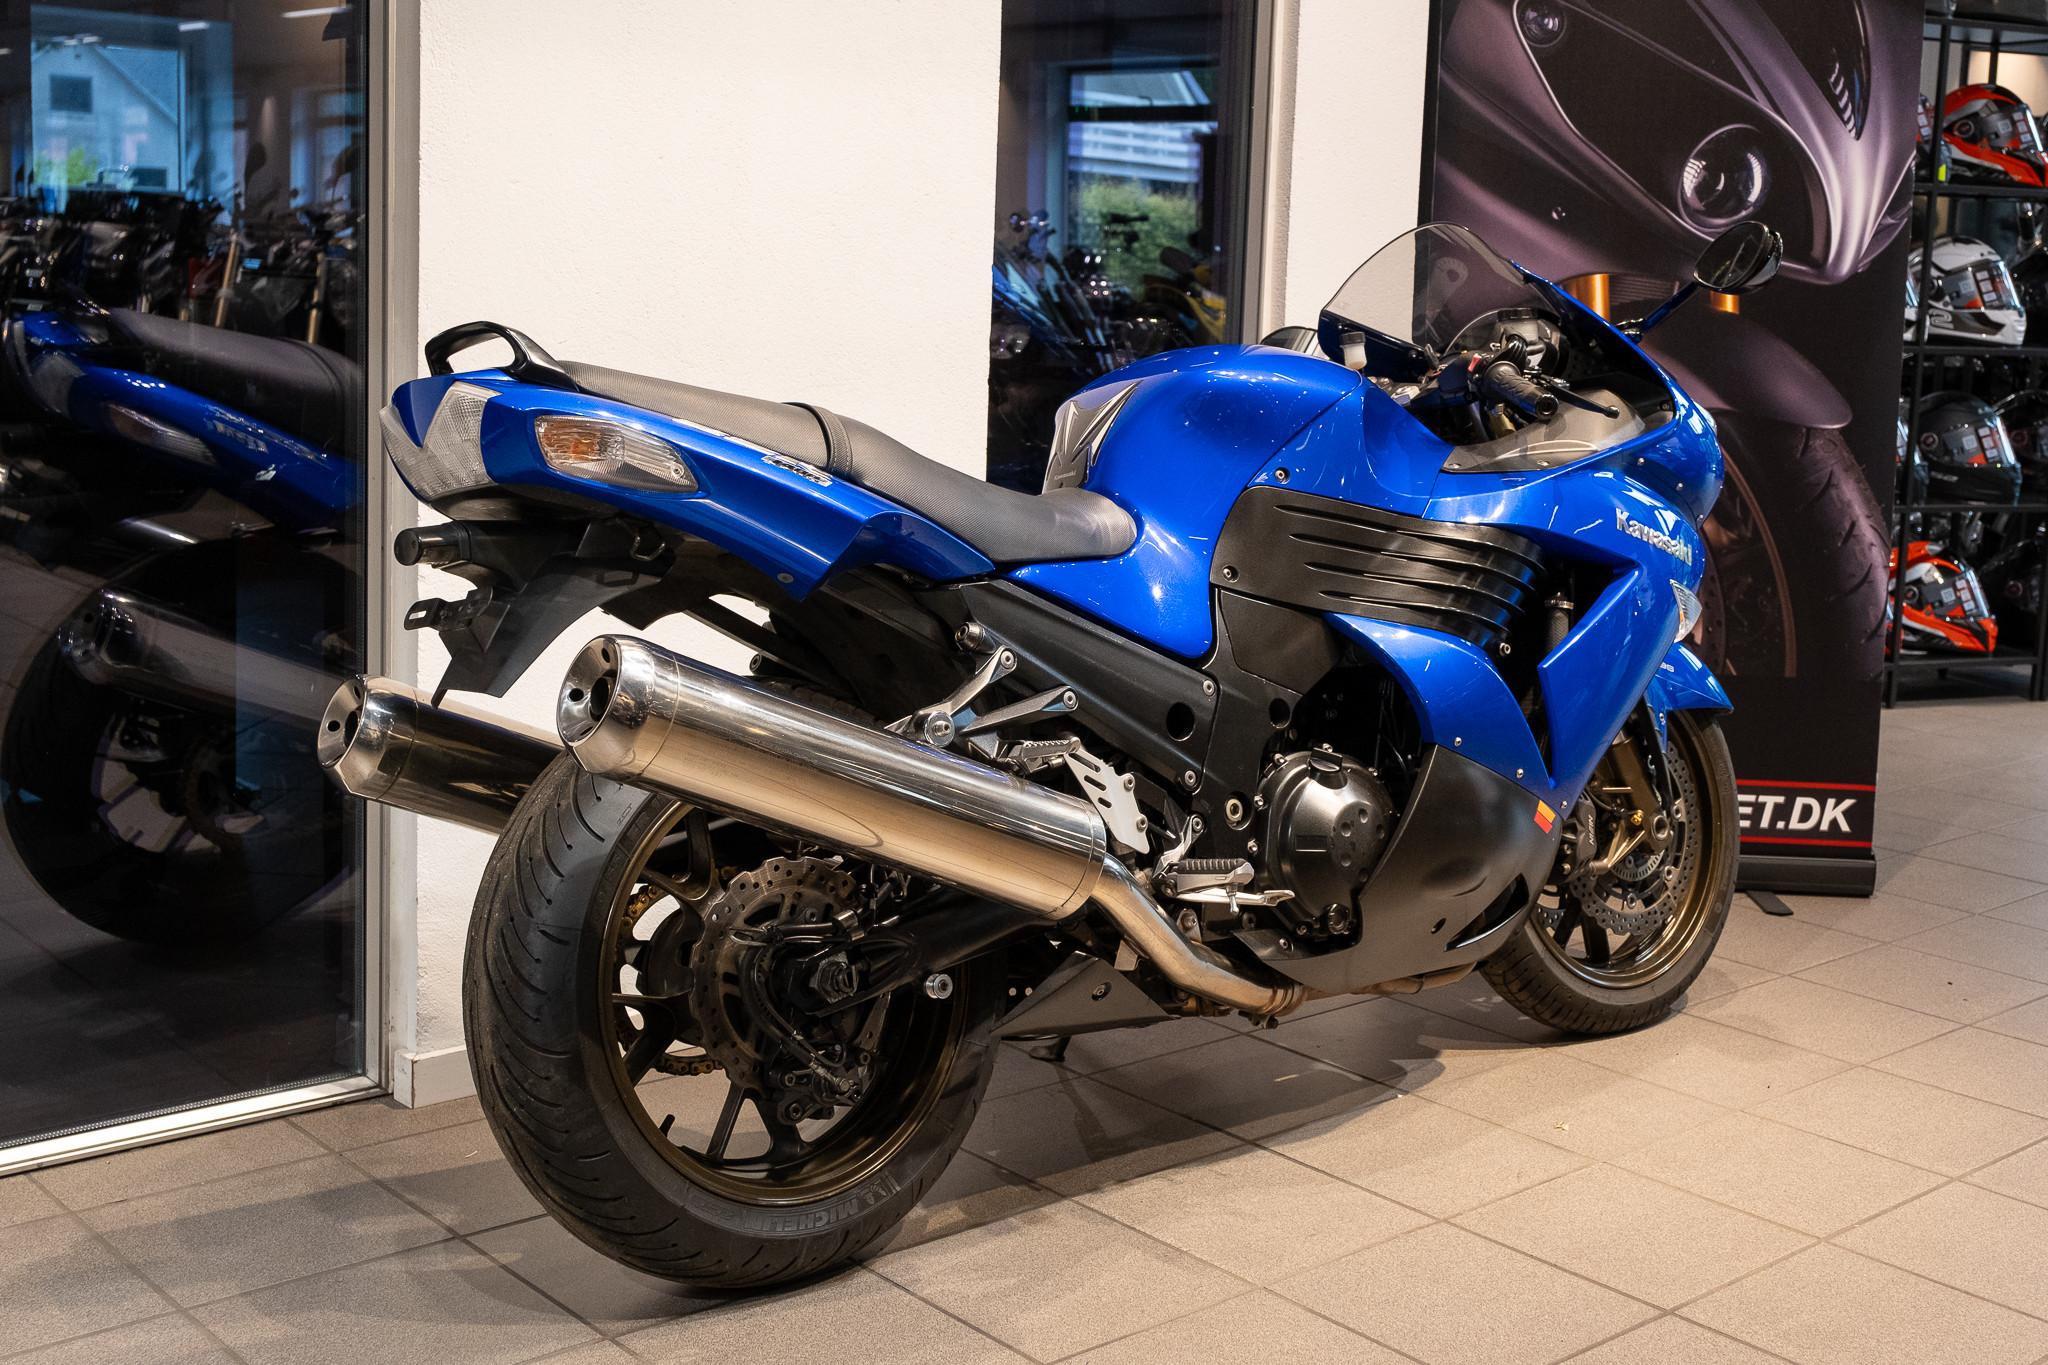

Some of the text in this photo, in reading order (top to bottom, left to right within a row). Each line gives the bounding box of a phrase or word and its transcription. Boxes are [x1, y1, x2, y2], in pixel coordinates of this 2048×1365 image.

[1615, 507, 1692, 566] Kawasaki
[1736, 794, 1857, 833] ET.DK
[745, 1198, 858, 1232] MICHELIN
